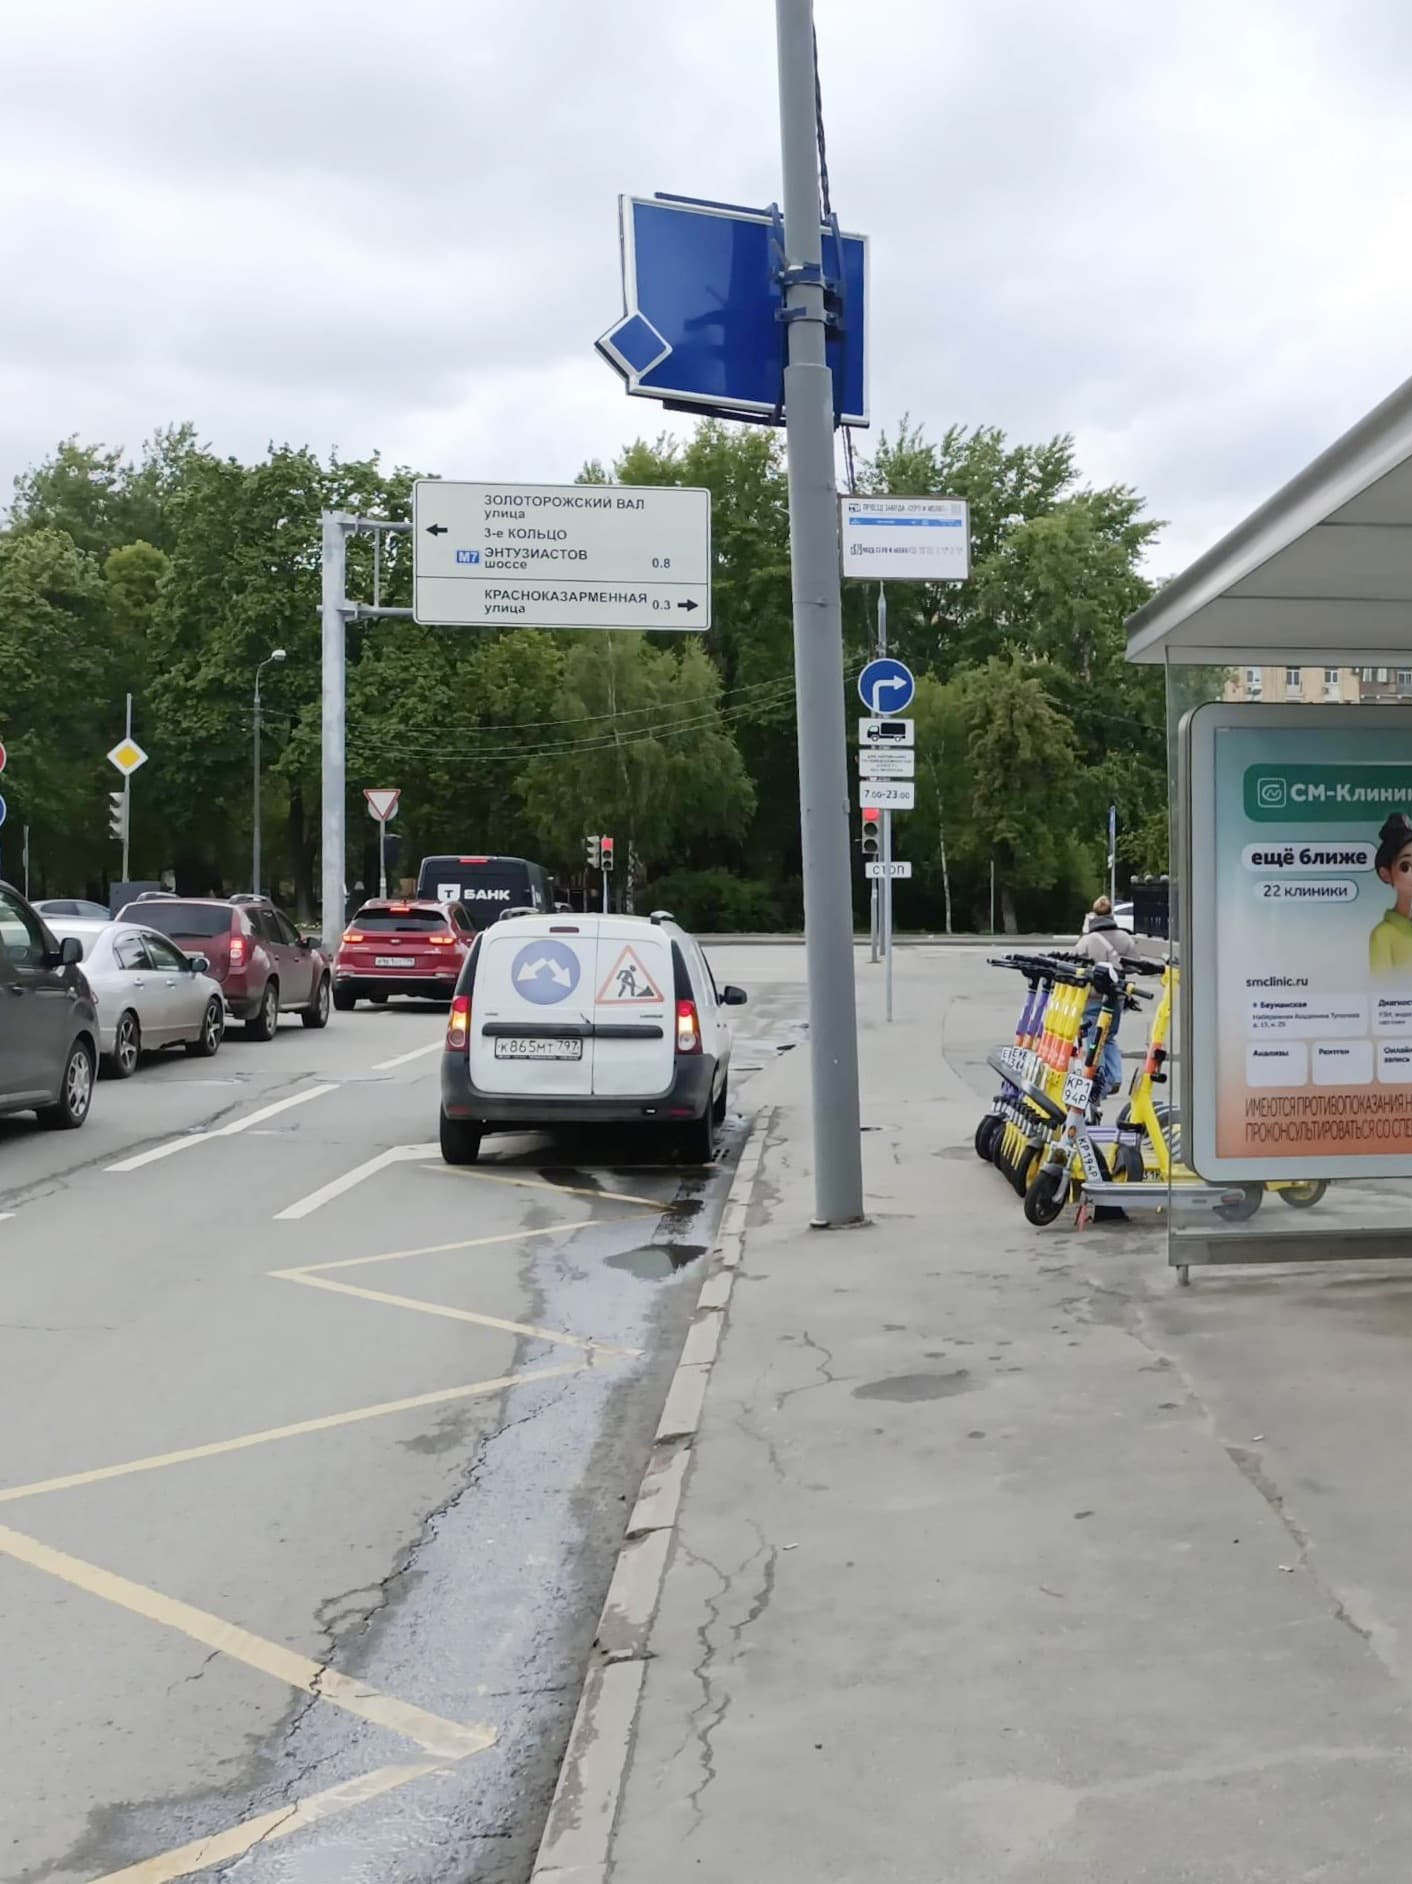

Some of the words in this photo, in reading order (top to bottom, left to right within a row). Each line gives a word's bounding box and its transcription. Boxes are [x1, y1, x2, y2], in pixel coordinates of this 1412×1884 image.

[484, 494, 612, 509] ЗОЛОТОРОЖСКИЙ
[616, 498, 645, 511] ВАЛ
[484, 509, 526, 520] улица
[484, 527, 504, 539] 3-е
[508, 528, 567, 541] КОЛЬЦО
[458, 551, 479, 563] М7
[484, 547, 588, 561] ЭНТУЗИАСТОВ
[484, 560, 528, 570] шоссе
[652, 558, 671, 569] 0.8
[484, 589, 648, 604] КРАСНОКАЗАРМЕННАЯ
[652, 600, 671, 611] 0.3
[484, 603, 526, 615] улица
[1251, 848, 1295, 868] ещё
[1299, 848, 1367, 865] ближе
[464, 889, 510, 900] БАНК
[1263, 885, 1281, 897] 22
[1284, 885, 1348, 897] клиники
[1246, 976, 1308, 987] smclinic.ru
[558, 1040, 578, 1050] 797
[1067, 1077, 1090, 1093] КР1
[1065, 1089, 1087, 1104] 94Р
[1246, 1096, 1295, 1117] ИМЕЮТСЯ
[1246, 1119, 1375, 1142] ПРОКОНСУЛЬТИРОВАТЬСЯ
[1376, 1119, 1391, 1138] СО
